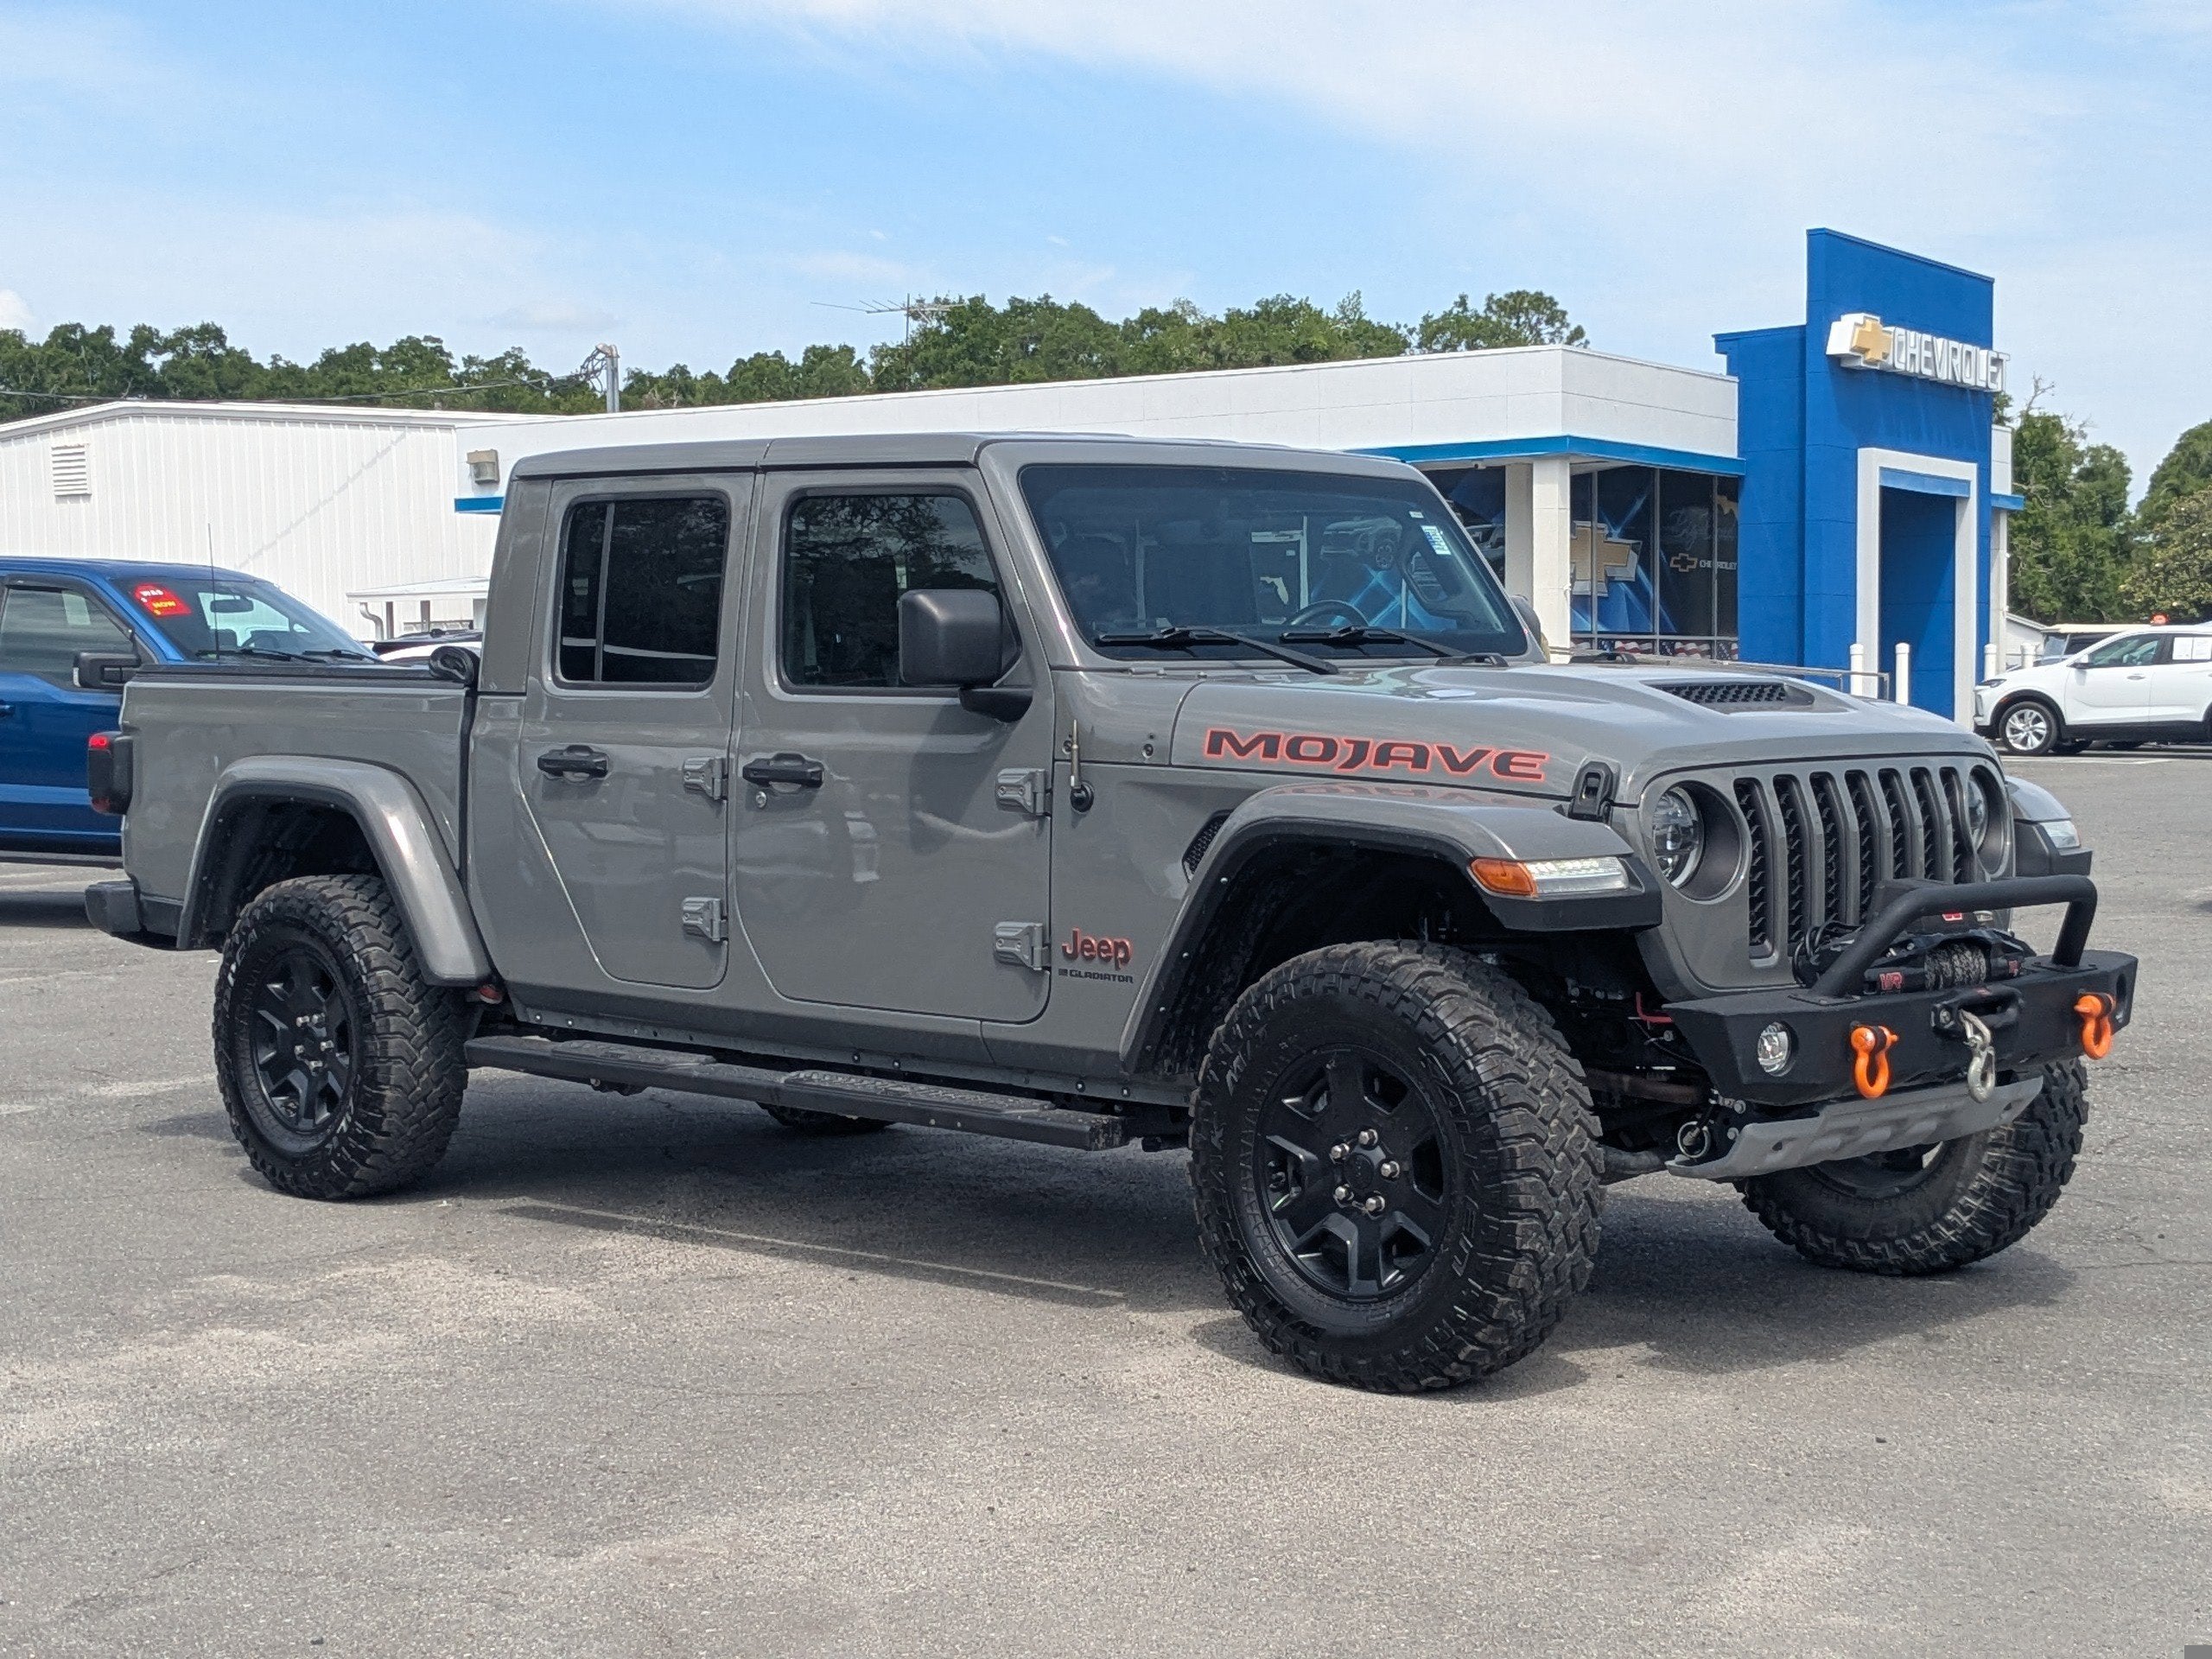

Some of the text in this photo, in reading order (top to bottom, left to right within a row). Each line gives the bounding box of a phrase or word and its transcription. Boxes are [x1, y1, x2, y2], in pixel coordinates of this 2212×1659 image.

[1892, 326, 2011, 392] CHEVROLET
[1205, 728, 1549, 781] MOJAVE
[1061, 927, 1133, 971] Jeep
[1069, 969, 1134, 984] GLADIATOR
